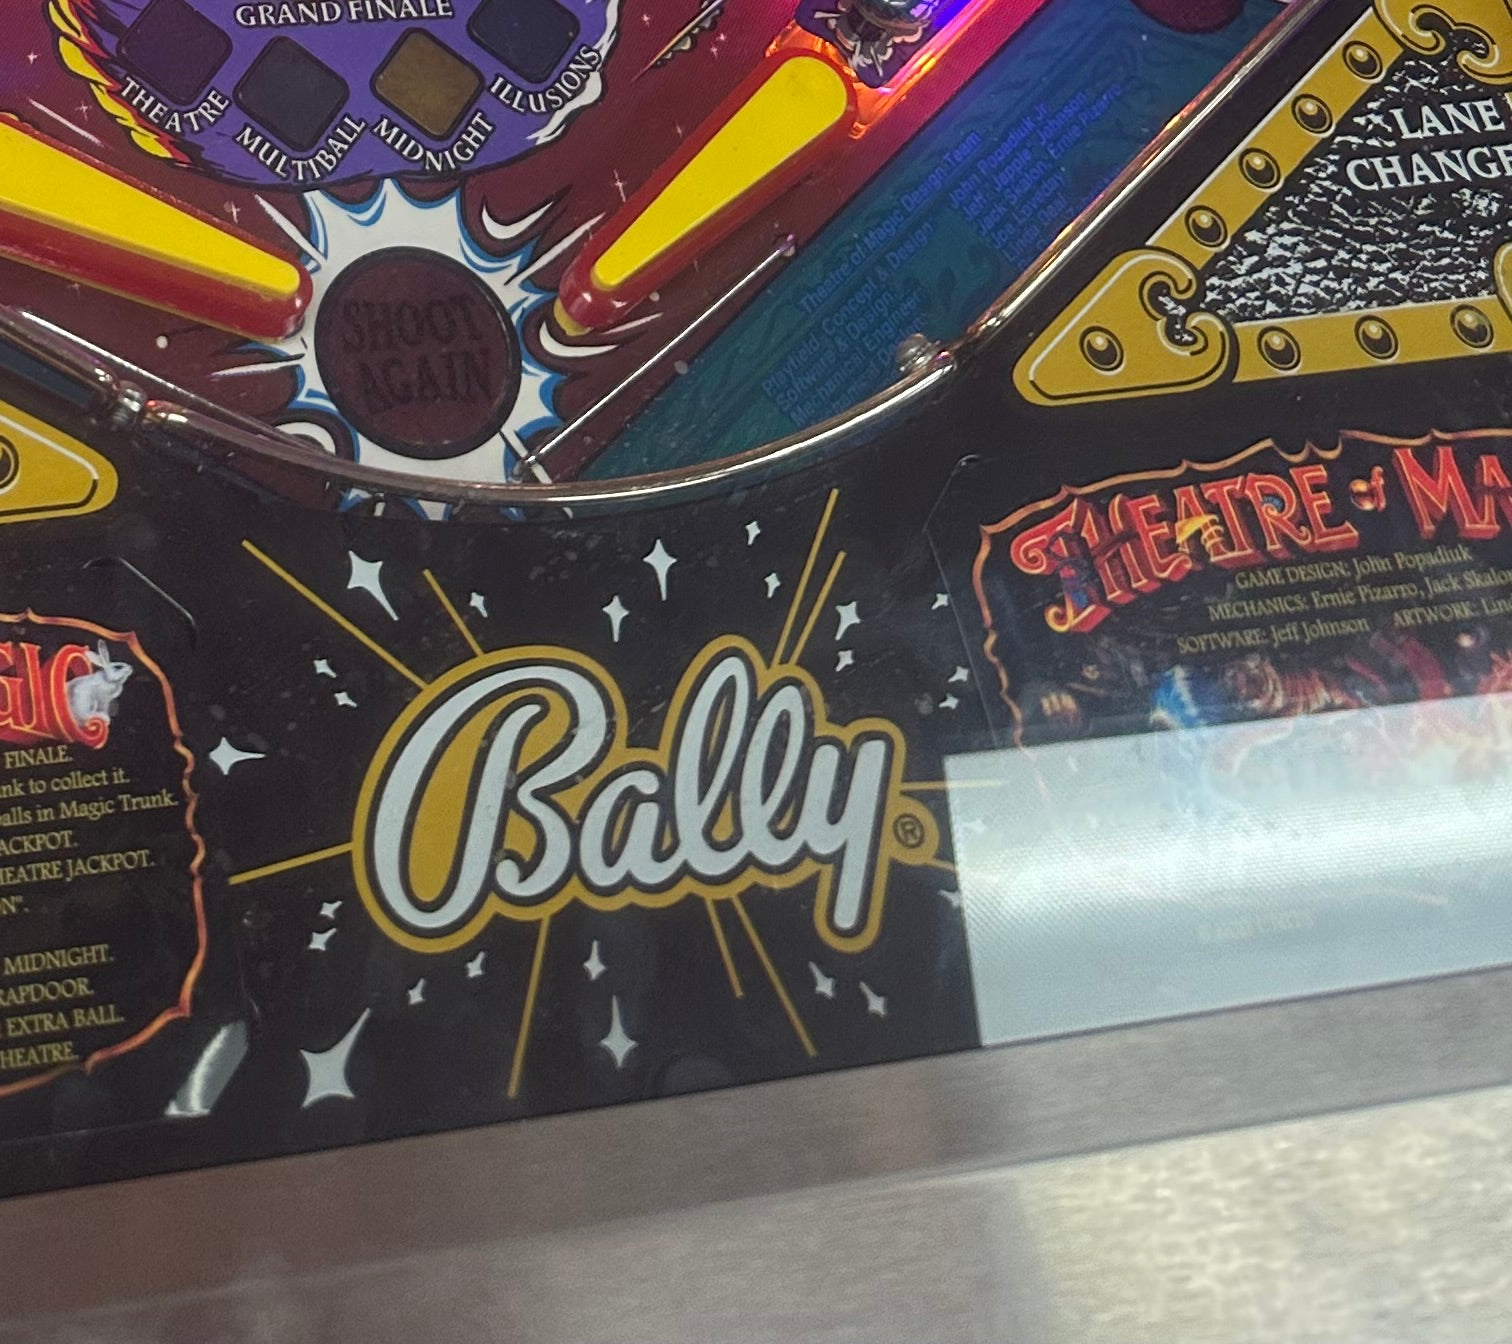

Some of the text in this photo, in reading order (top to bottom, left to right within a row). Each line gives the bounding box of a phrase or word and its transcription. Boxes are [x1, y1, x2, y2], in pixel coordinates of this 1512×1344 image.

[235, 0, 341, 26] GRAND
[122, 76, 230, 132] THEATRE
[490, 45, 600, 112] ILLUSIONS
[373, 111, 495, 172] MIDNIGHT
[1389, 98, 1506, 139] LANE
[235, 115, 366, 182] MULTIBALL
[343, 294, 483, 351] SHOOT
[359, 348, 492, 411] AGAIN
[1011, 464, 1359, 632] THEATRE
[1349, 466, 1385, 511] of
[1236, 543, 1473, 590] GAME DESIGN: John Popadiuk
[1208, 592, 1308, 622] MECHANICS:
[1311, 588, 1355, 609] Ernie
[1357, 581, 1426, 604] Pizarro,
[1425, 574, 1462, 601] Jack
[1177, 629, 1268, 655] SOFTWARE:
[1270, 618, 1300, 644] Jeff
[1303, 615, 1370, 643] Johnson
[1393, 600, 1478, 628] ARTWORK:
[4, 745, 73, 768] FINALE.
[29, 778, 47, 795] to
[50, 770, 109, 792] collect
[112, 768, 131, 785] it.
[37, 806, 56, 823] in
[59, 799, 117, 824] Magic
[119, 791, 179, 813] Trunk.
[374, 656, 886, 930] Bally
